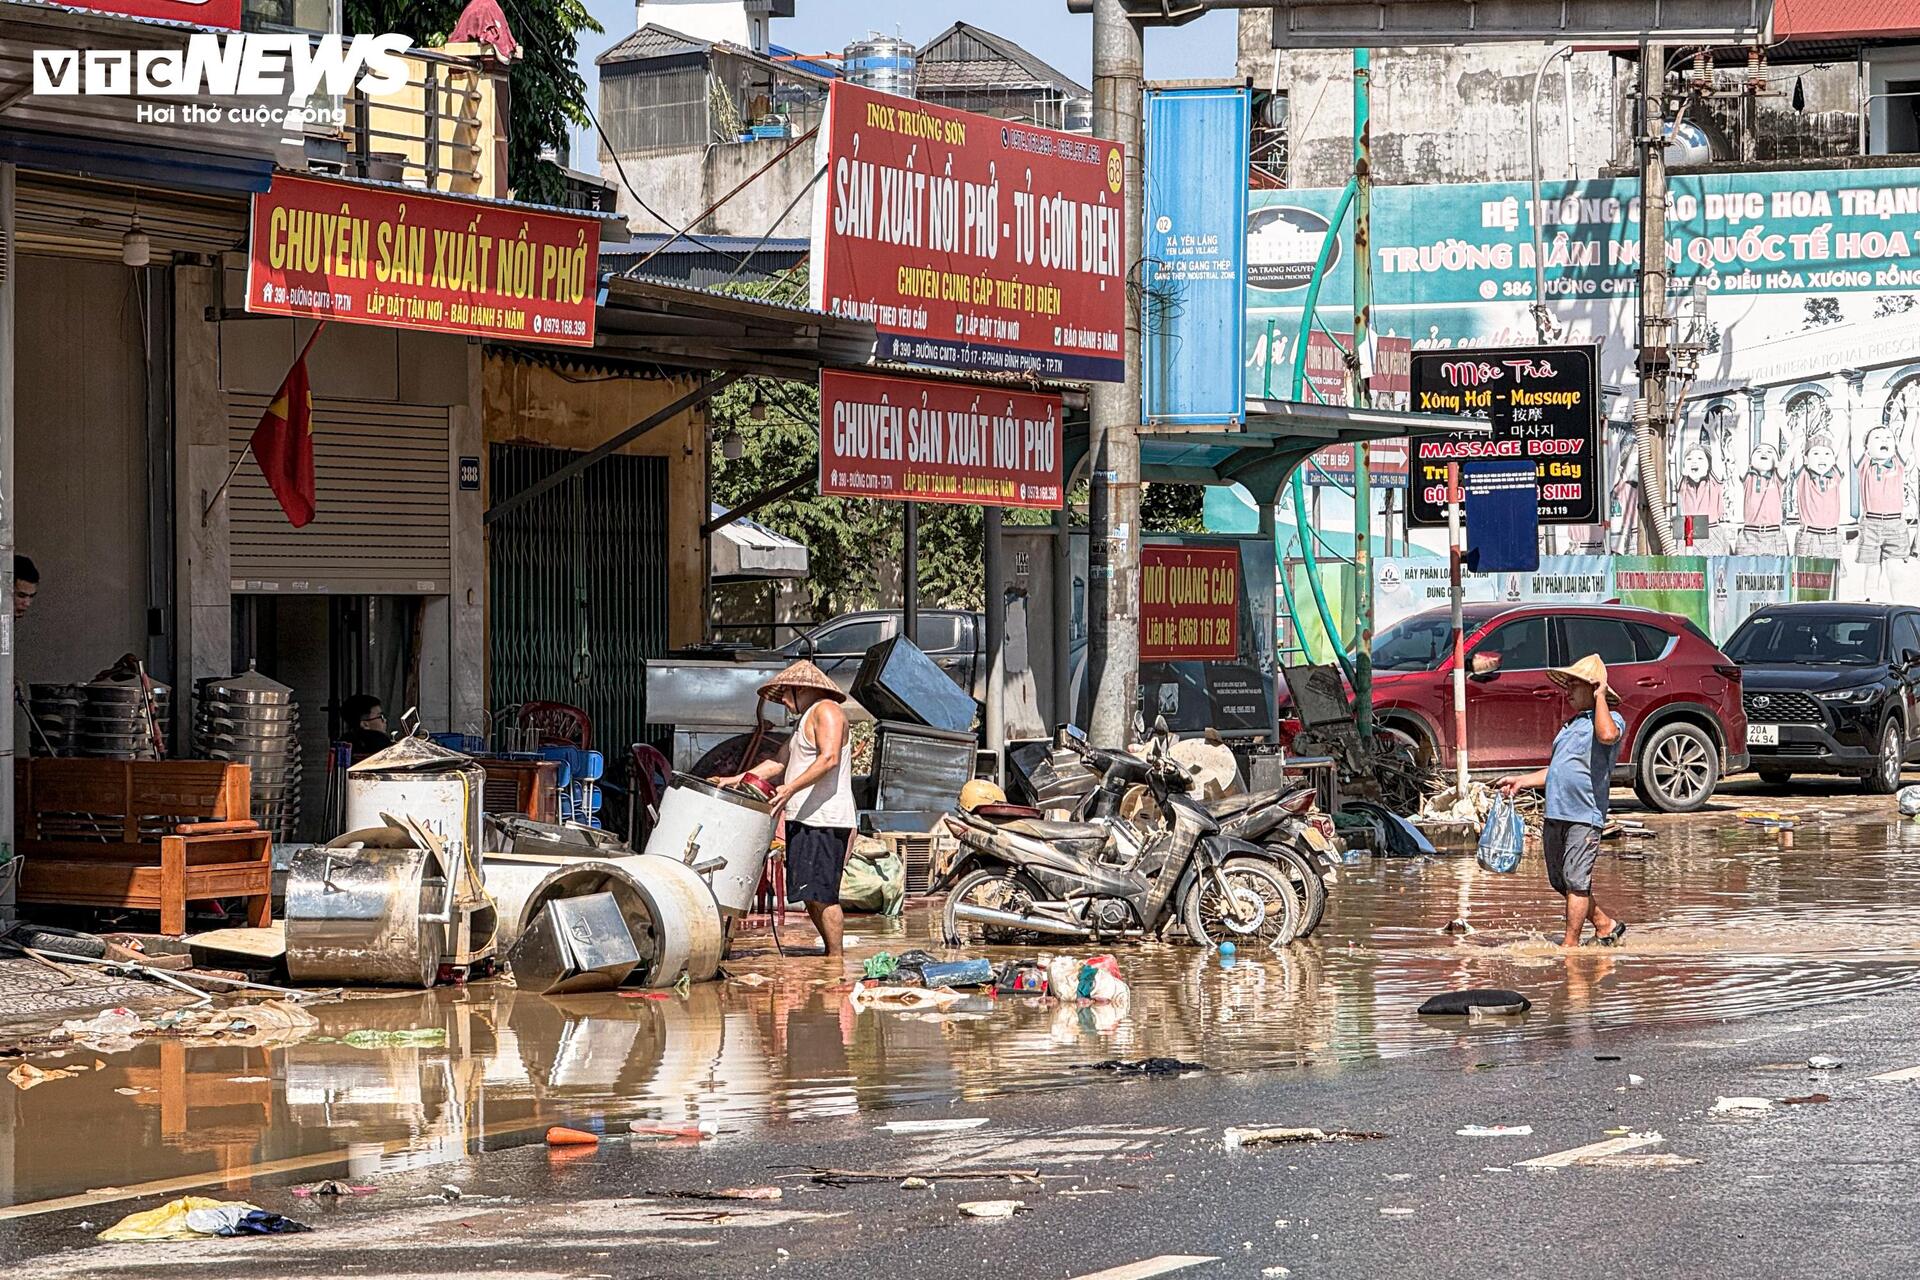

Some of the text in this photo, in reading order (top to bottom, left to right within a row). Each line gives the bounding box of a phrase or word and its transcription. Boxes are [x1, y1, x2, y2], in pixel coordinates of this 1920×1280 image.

[866, 102, 966, 146] INOX TRƯỜNG SƠN
[1107, 159, 1122, 184] 68
[834, 132, 1120, 292] SẢN XUẤT NỒI PHỞ TỦ CƠM ĐIỆN
[1481, 196, 1519, 232] HỆ
[1705, 192, 1764, 225] DỤC
[1772, 190, 1833, 218] HOA
[1838, 186, 1920, 220] TRẠN
[1158, 219, 1169, 231] 02
[269, 203, 588, 305] CHUYÊN SẢN XUẤT NỒI PHỞ
[1378, 239, 1513, 274] TRƯỜNG
[1688, 225, 1786, 270] QUỐC
[1789, 223, 1832, 260] TẾ
[1836, 231, 1911, 259] HOA
[1189, 260, 1210, 271] GANG
[897, 265, 1061, 320] CHUYÊN CUNG CẤP THIẾT BỊ ĐIỆN
[1502, 281, 1532, 297] 386
[1724, 268, 1762, 290] ĐIỀU
[1766, 269, 1804, 290] HÒA
[1803, 269, 1872, 288] XƯƠNG
[274, 286, 286, 304] 390
[290, 284, 313, 307] ĐƯỜNG
[367, 287, 525, 330] LẮP ĐẶT TẬN NƠI BẢO HÀNH 5 NĂM
[879, 304, 896, 327] THEO
[898, 304, 912, 329] YÊU
[543, 317, 586, 336] 0979.168.398
[965, 309, 1020, 343] LẮP ĐẶT TẬN NƠI
[1063, 322, 1119, 352] BẢO HÀNH 5 NĂM
[900, 342, 911, 357] 390
[915, 341, 938, 361] ĐƯỜNG
[939, 346, 957, 363] CMT8
[960, 342, 970, 364] TỔ
[970, 349, 978, 363] 17
[981, 351, 1004, 366] P.PHAN
[1004, 349, 1020, 368] ĐÌNH
[1046, 359, 1063, 373] TP.TN
[1441, 358, 1558, 387] Mộc Trà
[1419, 388, 1581, 413] Xông Hơi Massage
[1512, 407, 1543, 422] 按摩
[833, 390, 1055, 473] CHUYÊN SẢN XUẤT NỒI PHỞ
[1511, 424, 1554, 439] 마사지
[1419, 440, 1522, 459] MASSAGE
[1528, 438, 1584, 456] BODY
[461, 466, 478, 482] 388
[903, 466, 1015, 498] LẮP ĐẶT TẬN NƠI BẢO HÀNH 5 NĂM
[1549, 461, 1582, 480] Gáy
[1543, 484, 1582, 500] SINH
[1143, 554, 1235, 608] MỜI QUẢNG CÁO
[1405, 566, 1418, 580] HÃY
[1532, 573, 1544, 593] HÃY
[1563, 576, 1577, 597] LOẠI
[1426, 585, 1446, 598] ĐÚNG
[1146, 617, 1230, 651] Liên hệ: 0368 161 283
[1750, 725, 1767, 735] 20A
